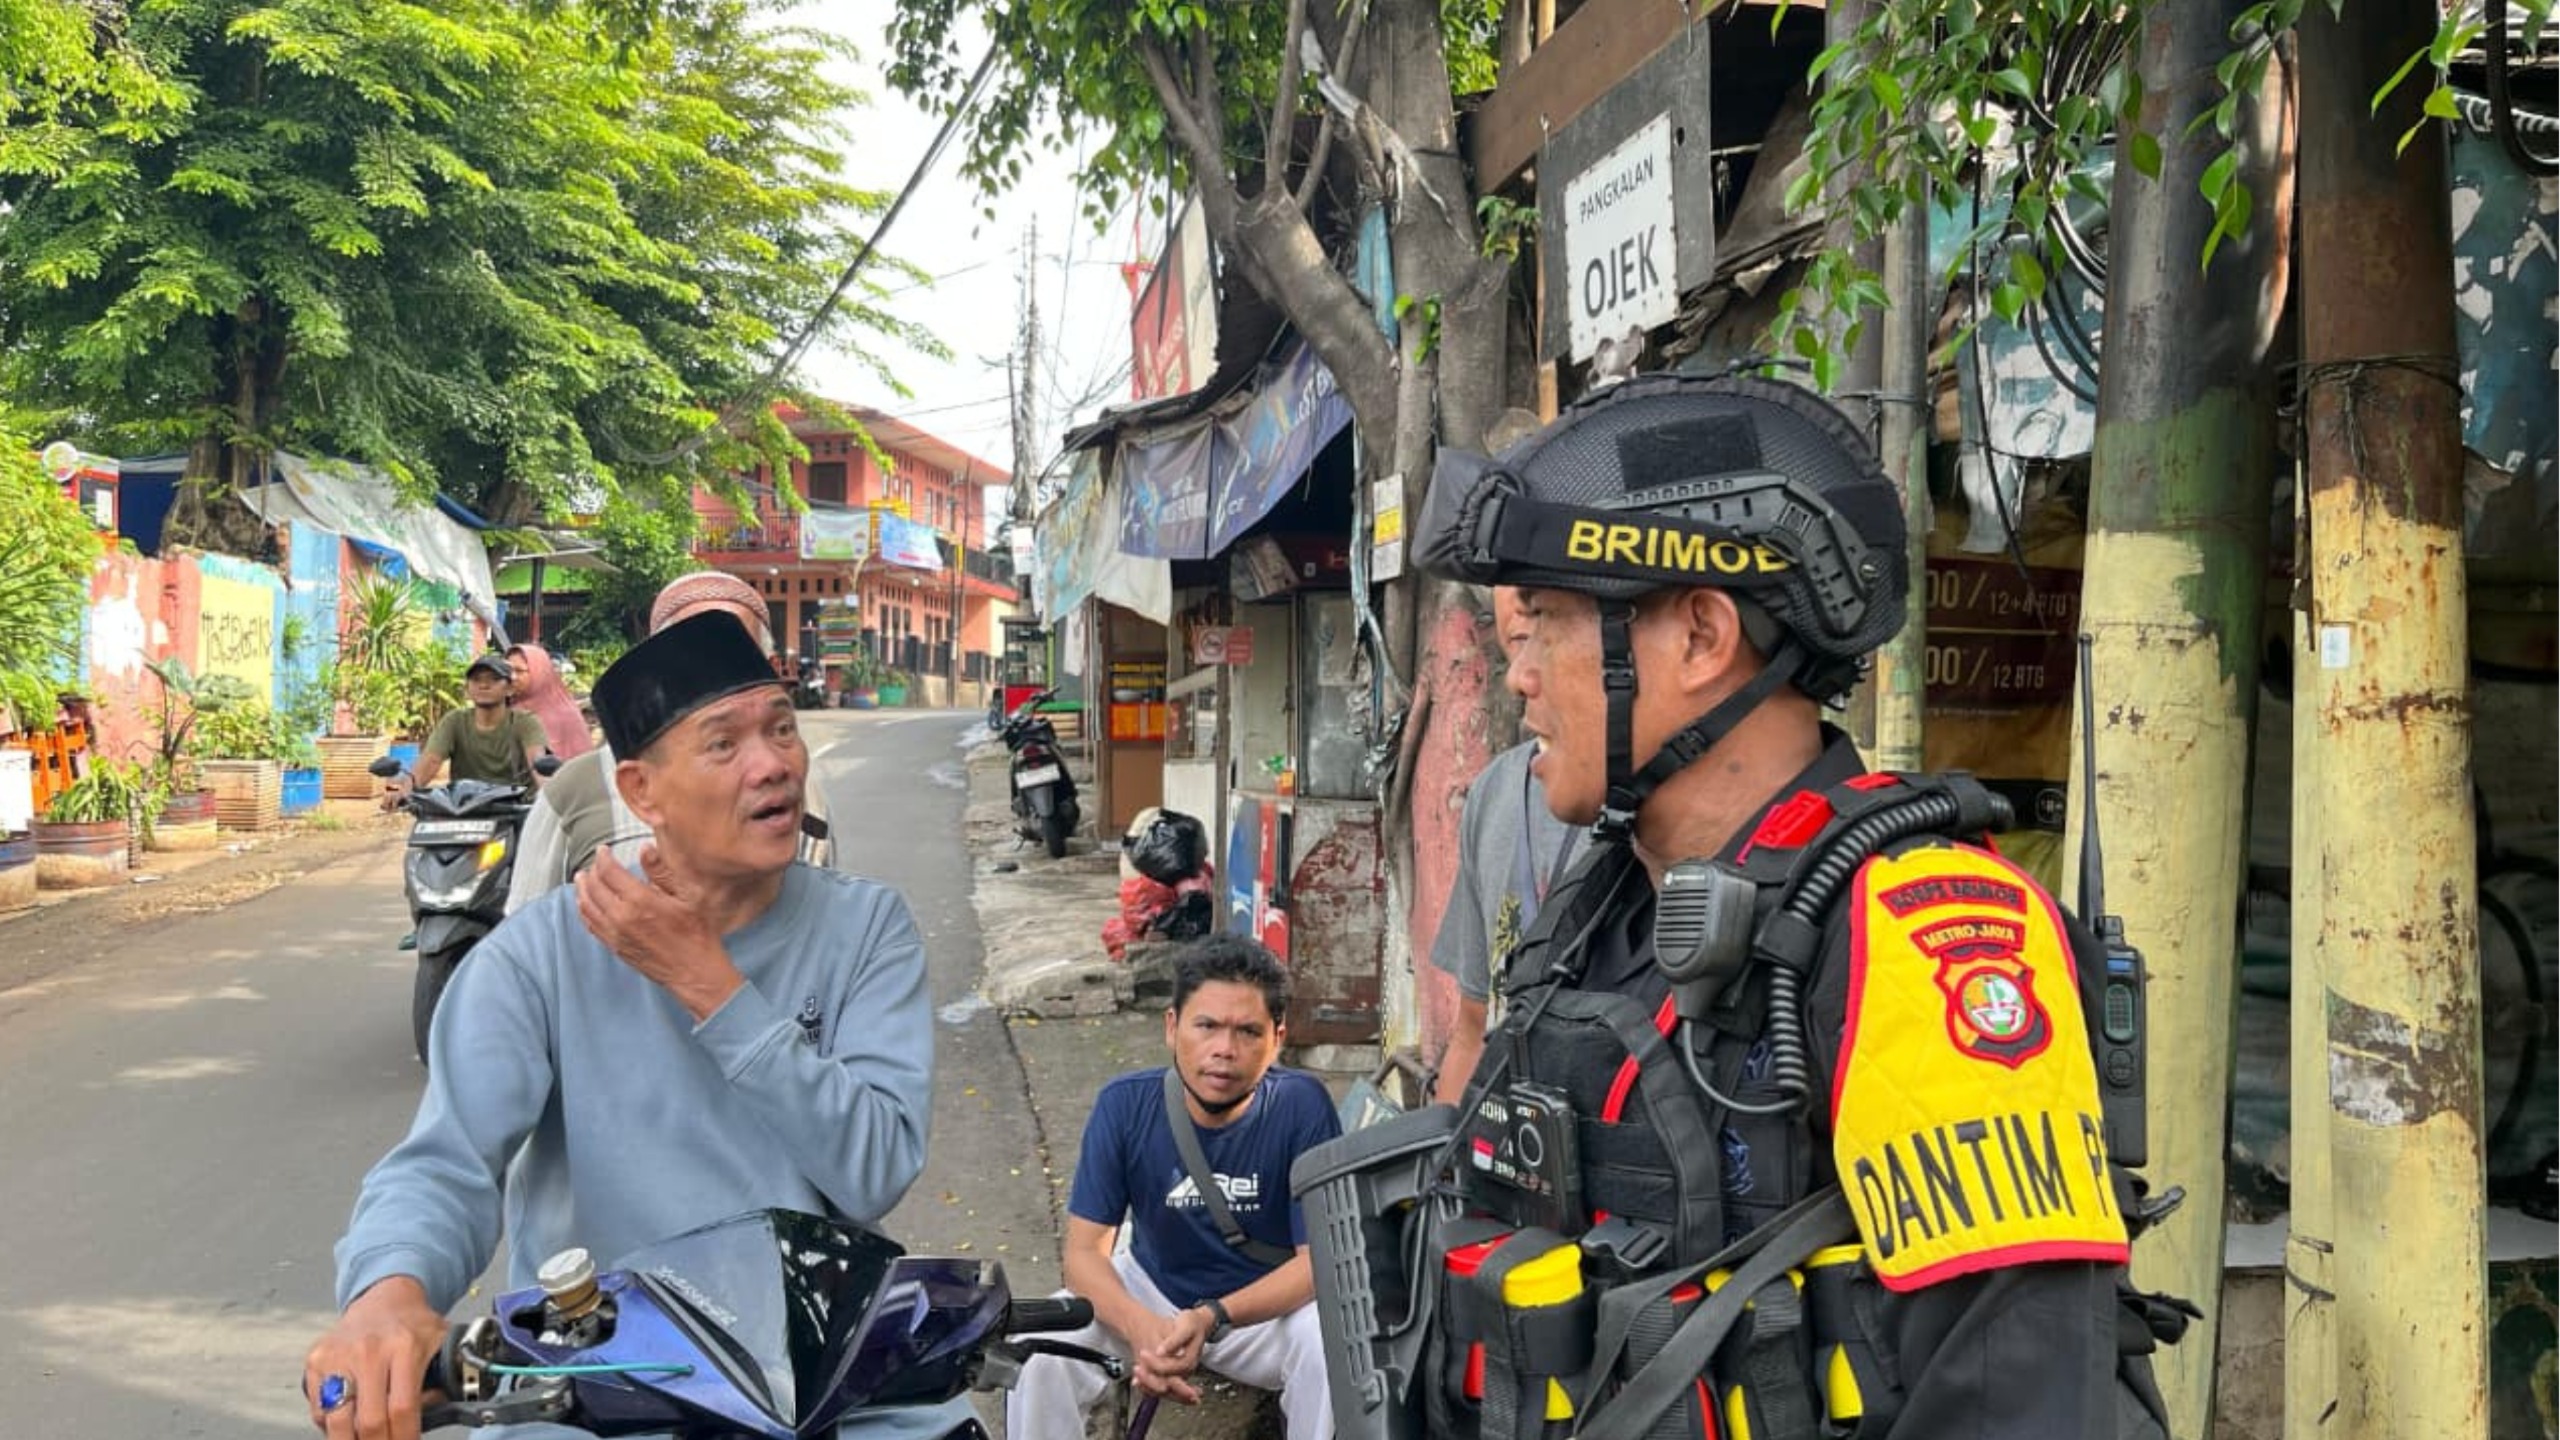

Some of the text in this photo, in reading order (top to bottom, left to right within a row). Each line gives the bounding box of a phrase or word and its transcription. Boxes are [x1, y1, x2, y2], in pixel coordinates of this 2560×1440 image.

[1579, 153, 1654, 224] PANGKALAN
[1584, 224, 1659, 319] OJEK
[1993, 665, 2010, 688] 12
[2015, 665, 2044, 689] BTG
[1855, 1111, 2077, 1259] DANTIM
